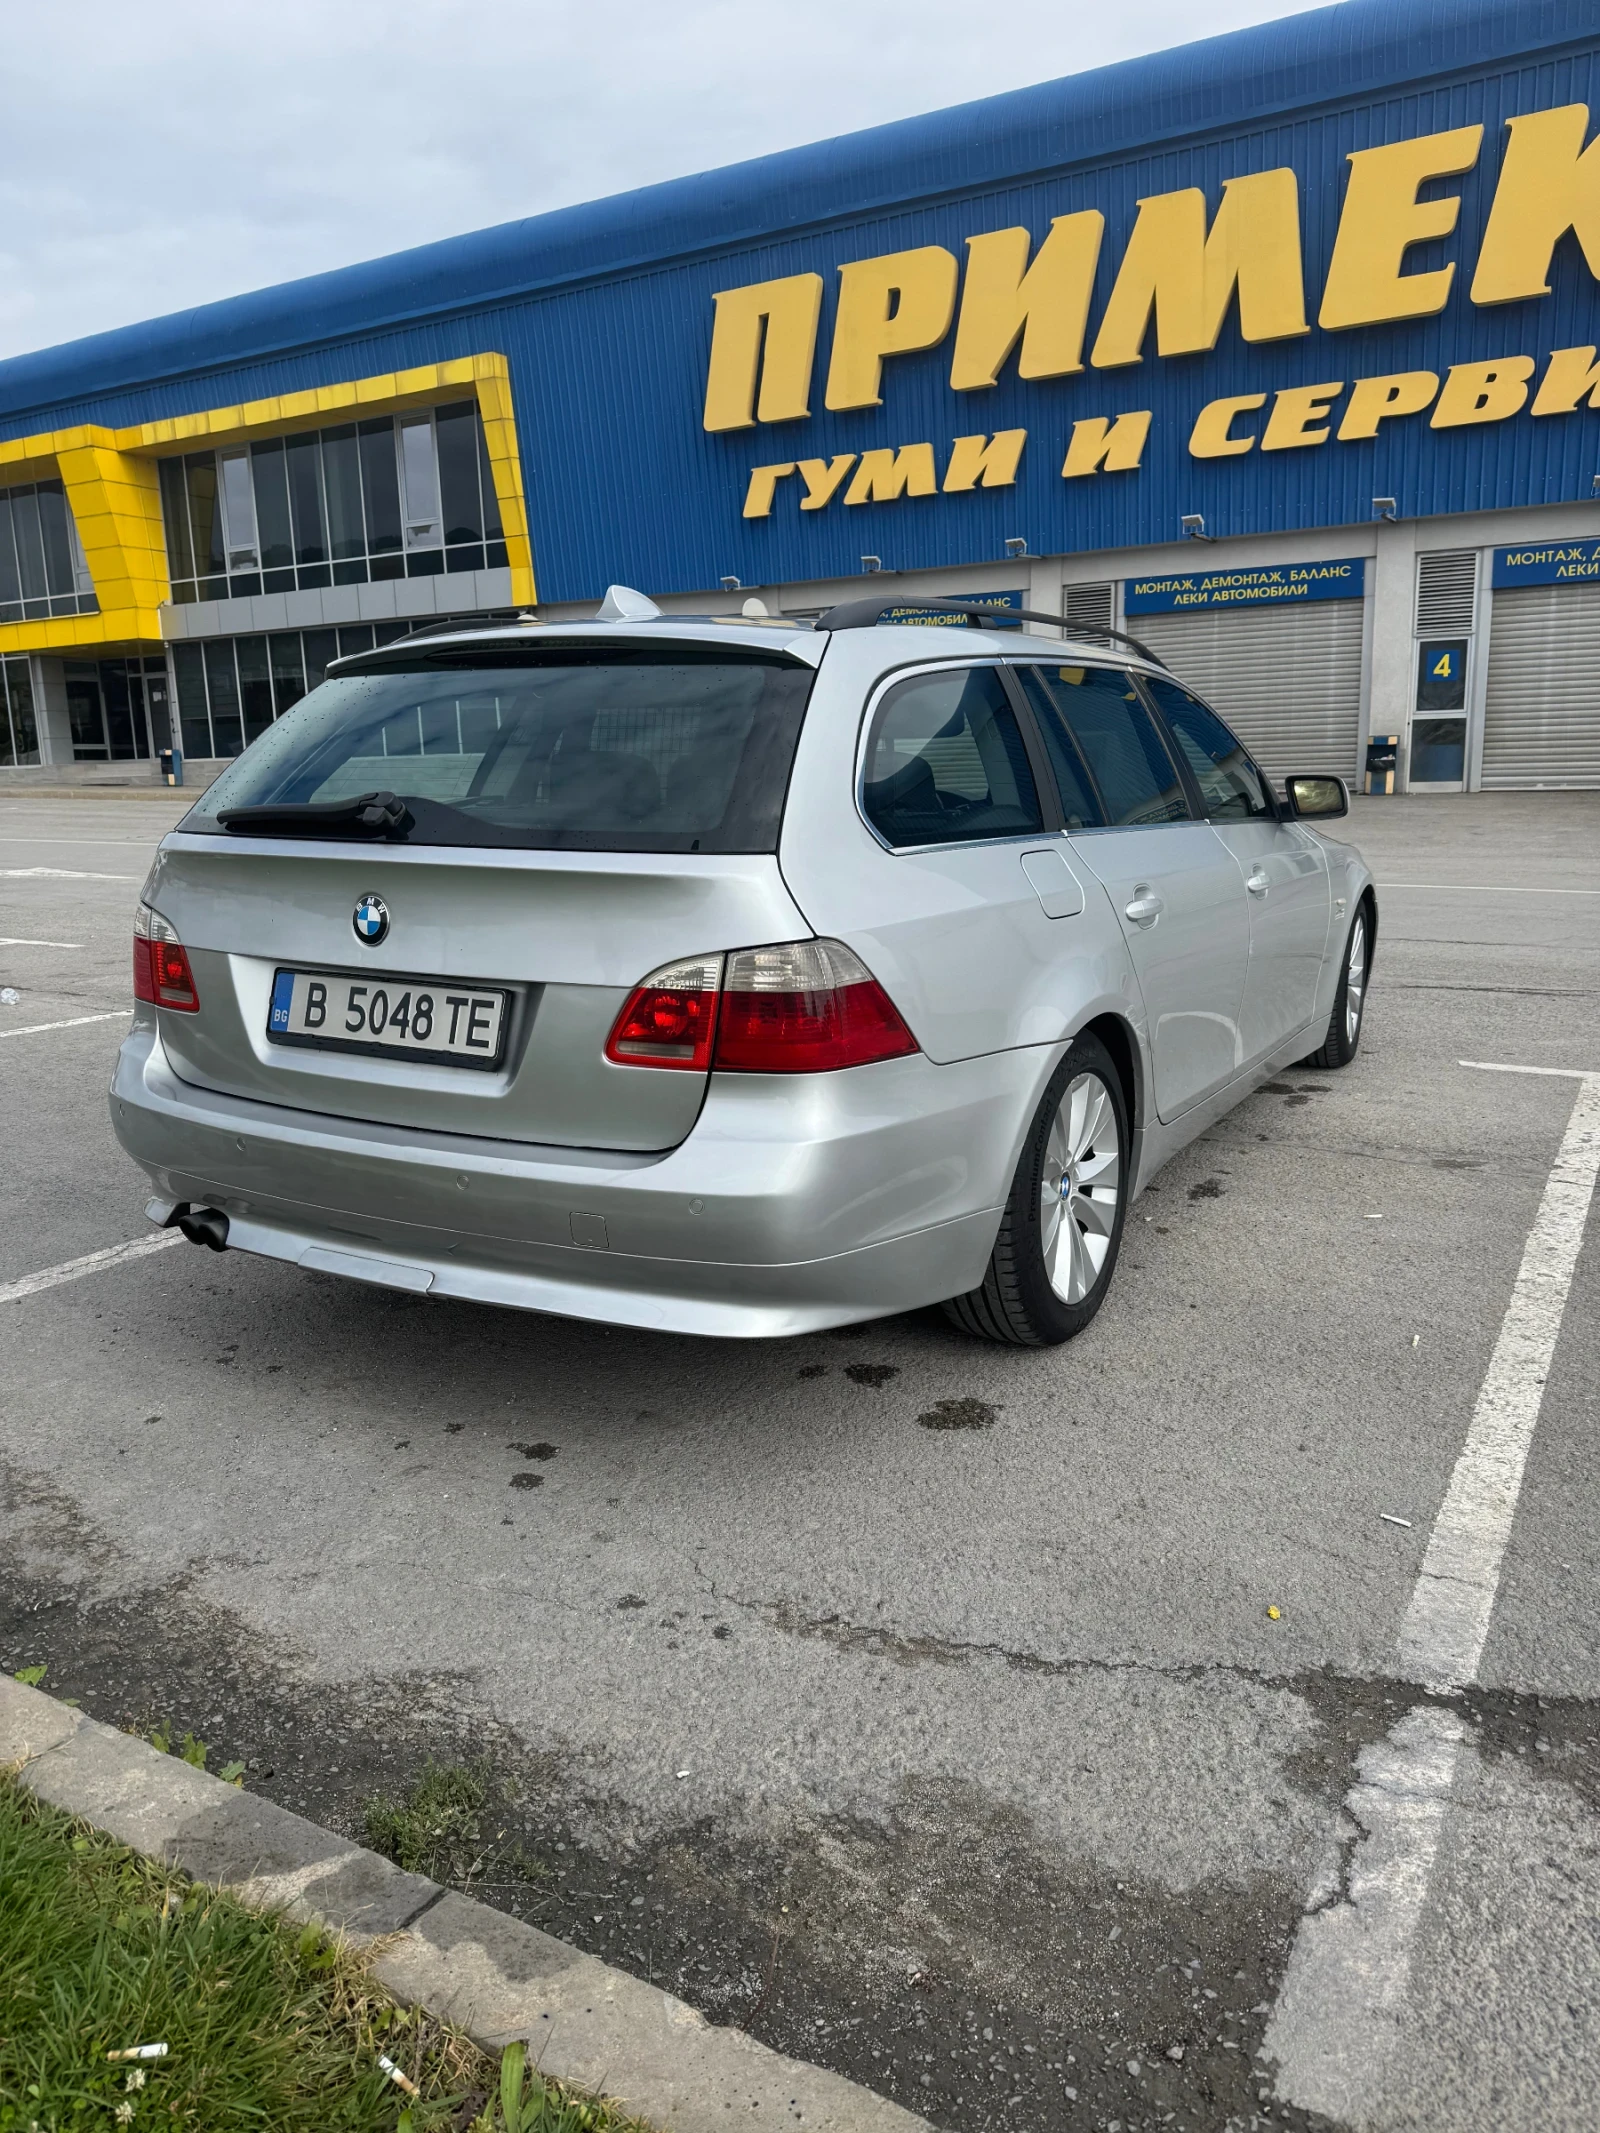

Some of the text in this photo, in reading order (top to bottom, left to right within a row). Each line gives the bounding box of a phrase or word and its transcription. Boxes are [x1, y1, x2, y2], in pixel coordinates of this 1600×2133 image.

[703, 103, 1600, 433] ПРИМЕК
[743, 429, 1027, 519] ГУМИ
[1061, 411, 1152, 478] И
[1506, 547, 1587, 566] МОНТАЖ,
[1135, 565, 1352, 595] МОНТАЖ, ДЕМОНТАЖ, БАЛАНС
[1556, 562, 1599, 577] ЛЕКИ
[1173, 583, 1308, 605] ЛЕКИ АВТОМОБИЛИ
[1433, 653, 1451, 677] 4
[356, 897, 386, 914] BMW
[273, 1008, 288, 1023] BG
[304, 982, 495, 1048] B 5048 TE
